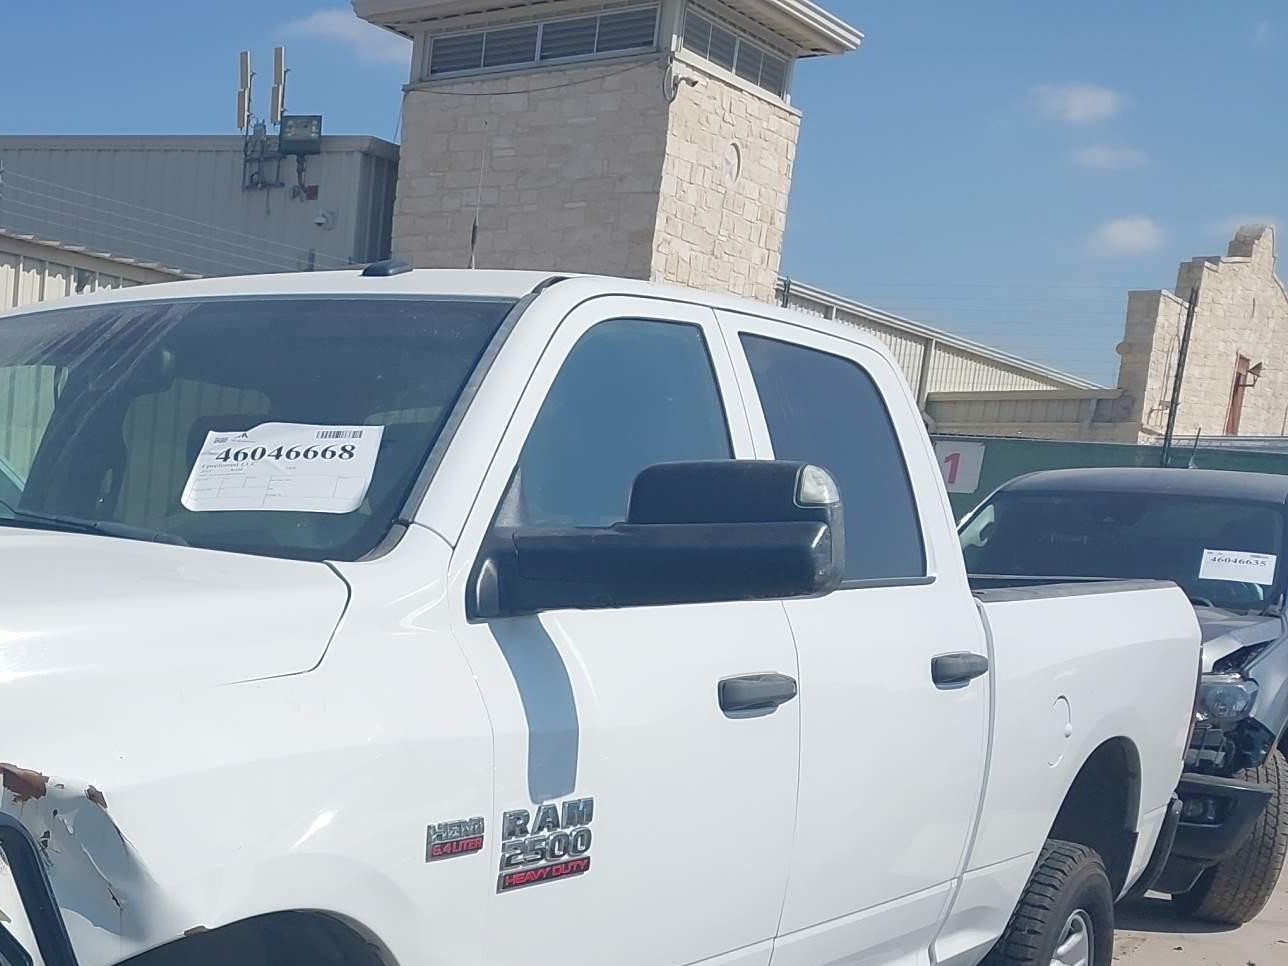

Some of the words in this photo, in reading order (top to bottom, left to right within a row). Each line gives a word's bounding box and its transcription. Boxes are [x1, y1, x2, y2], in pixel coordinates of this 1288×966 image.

[215, 444, 356, 463] 46046668
[943, 452, 961, 484] 1
[1210, 556, 1267, 567] 46046635
[502, 797, 593, 841] RAM
[501, 827, 592, 870] 2500
[504, 868, 551, 886] HEAVY
[553, 857, 588, 879] DUTY
